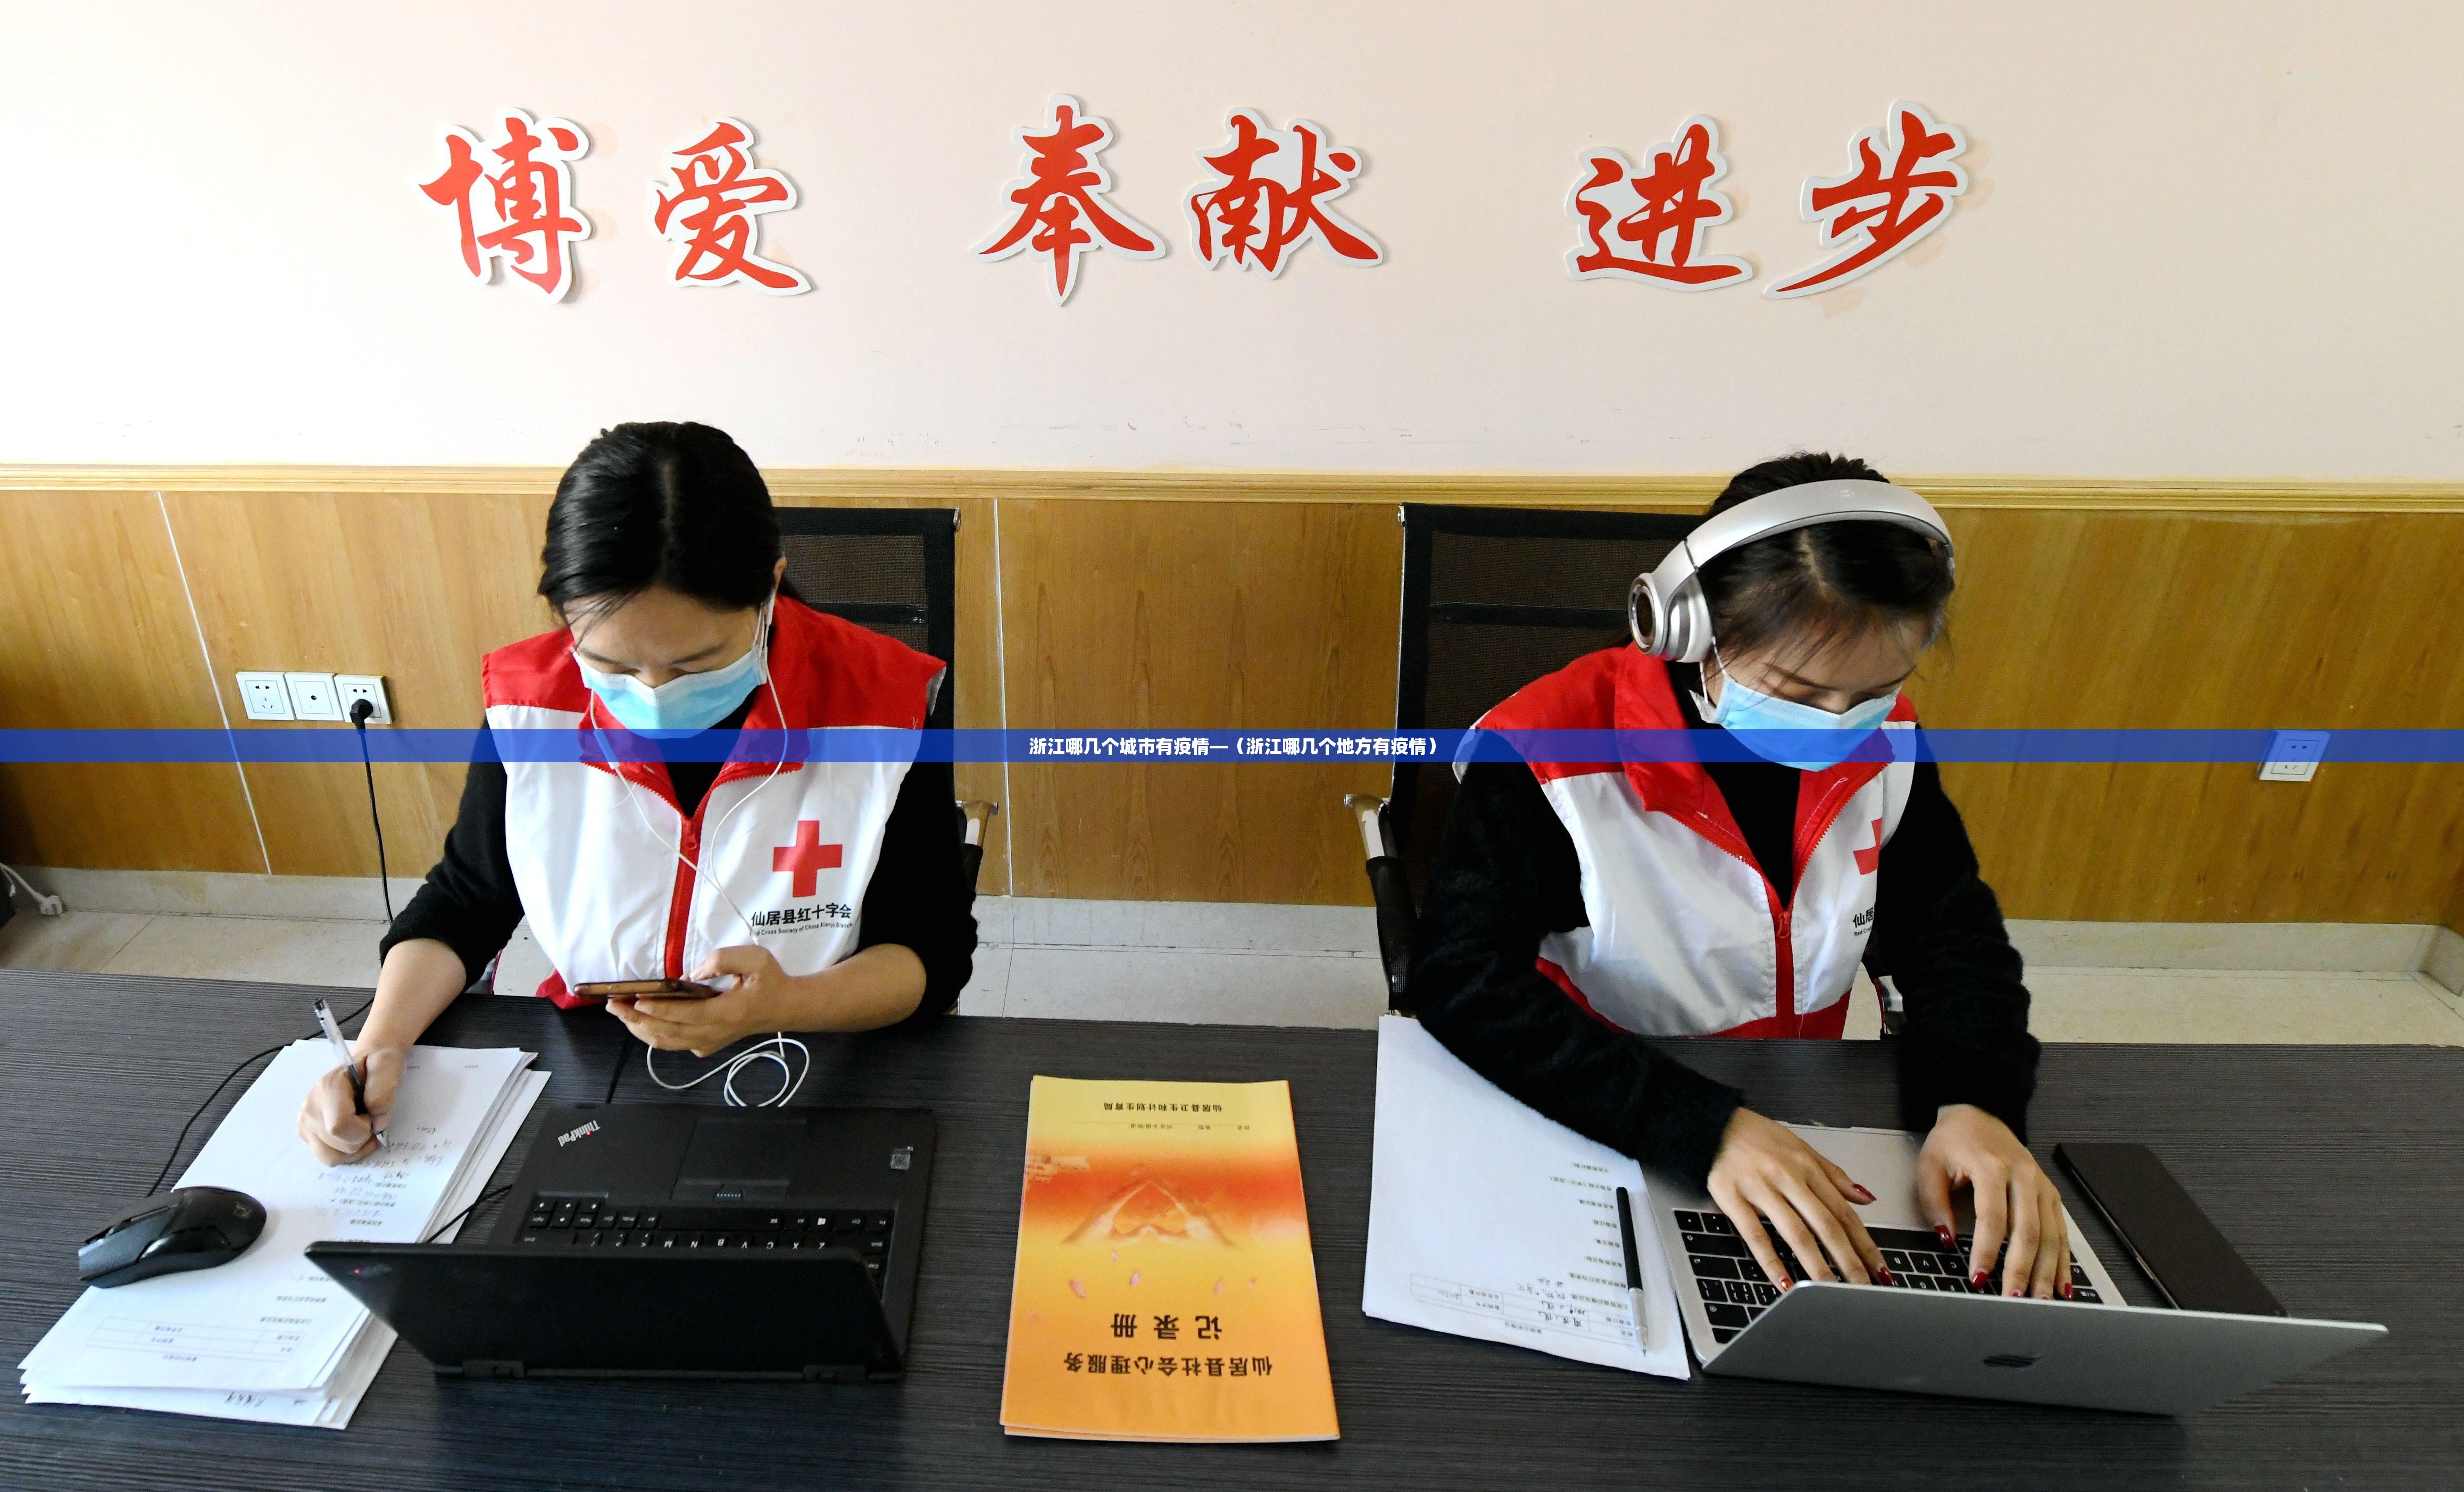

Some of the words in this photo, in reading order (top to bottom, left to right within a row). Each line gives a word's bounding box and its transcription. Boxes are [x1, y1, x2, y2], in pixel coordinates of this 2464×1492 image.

[422, 118, 799, 296] 博爱
[984, 105, 1379, 298] 奉献
[1576, 111, 1958, 294] 进步
[751, 903, 852, 927] 仙居县红十字会
[1104, 1103, 1223, 1113] 仙居县卫生和计划生育局
[557, 1120, 601, 1147] ThinkPad
[1110, 1313, 1223, 1341] 记录册
[1063, 1352, 1273, 1378] 仙居县社会心理服务
